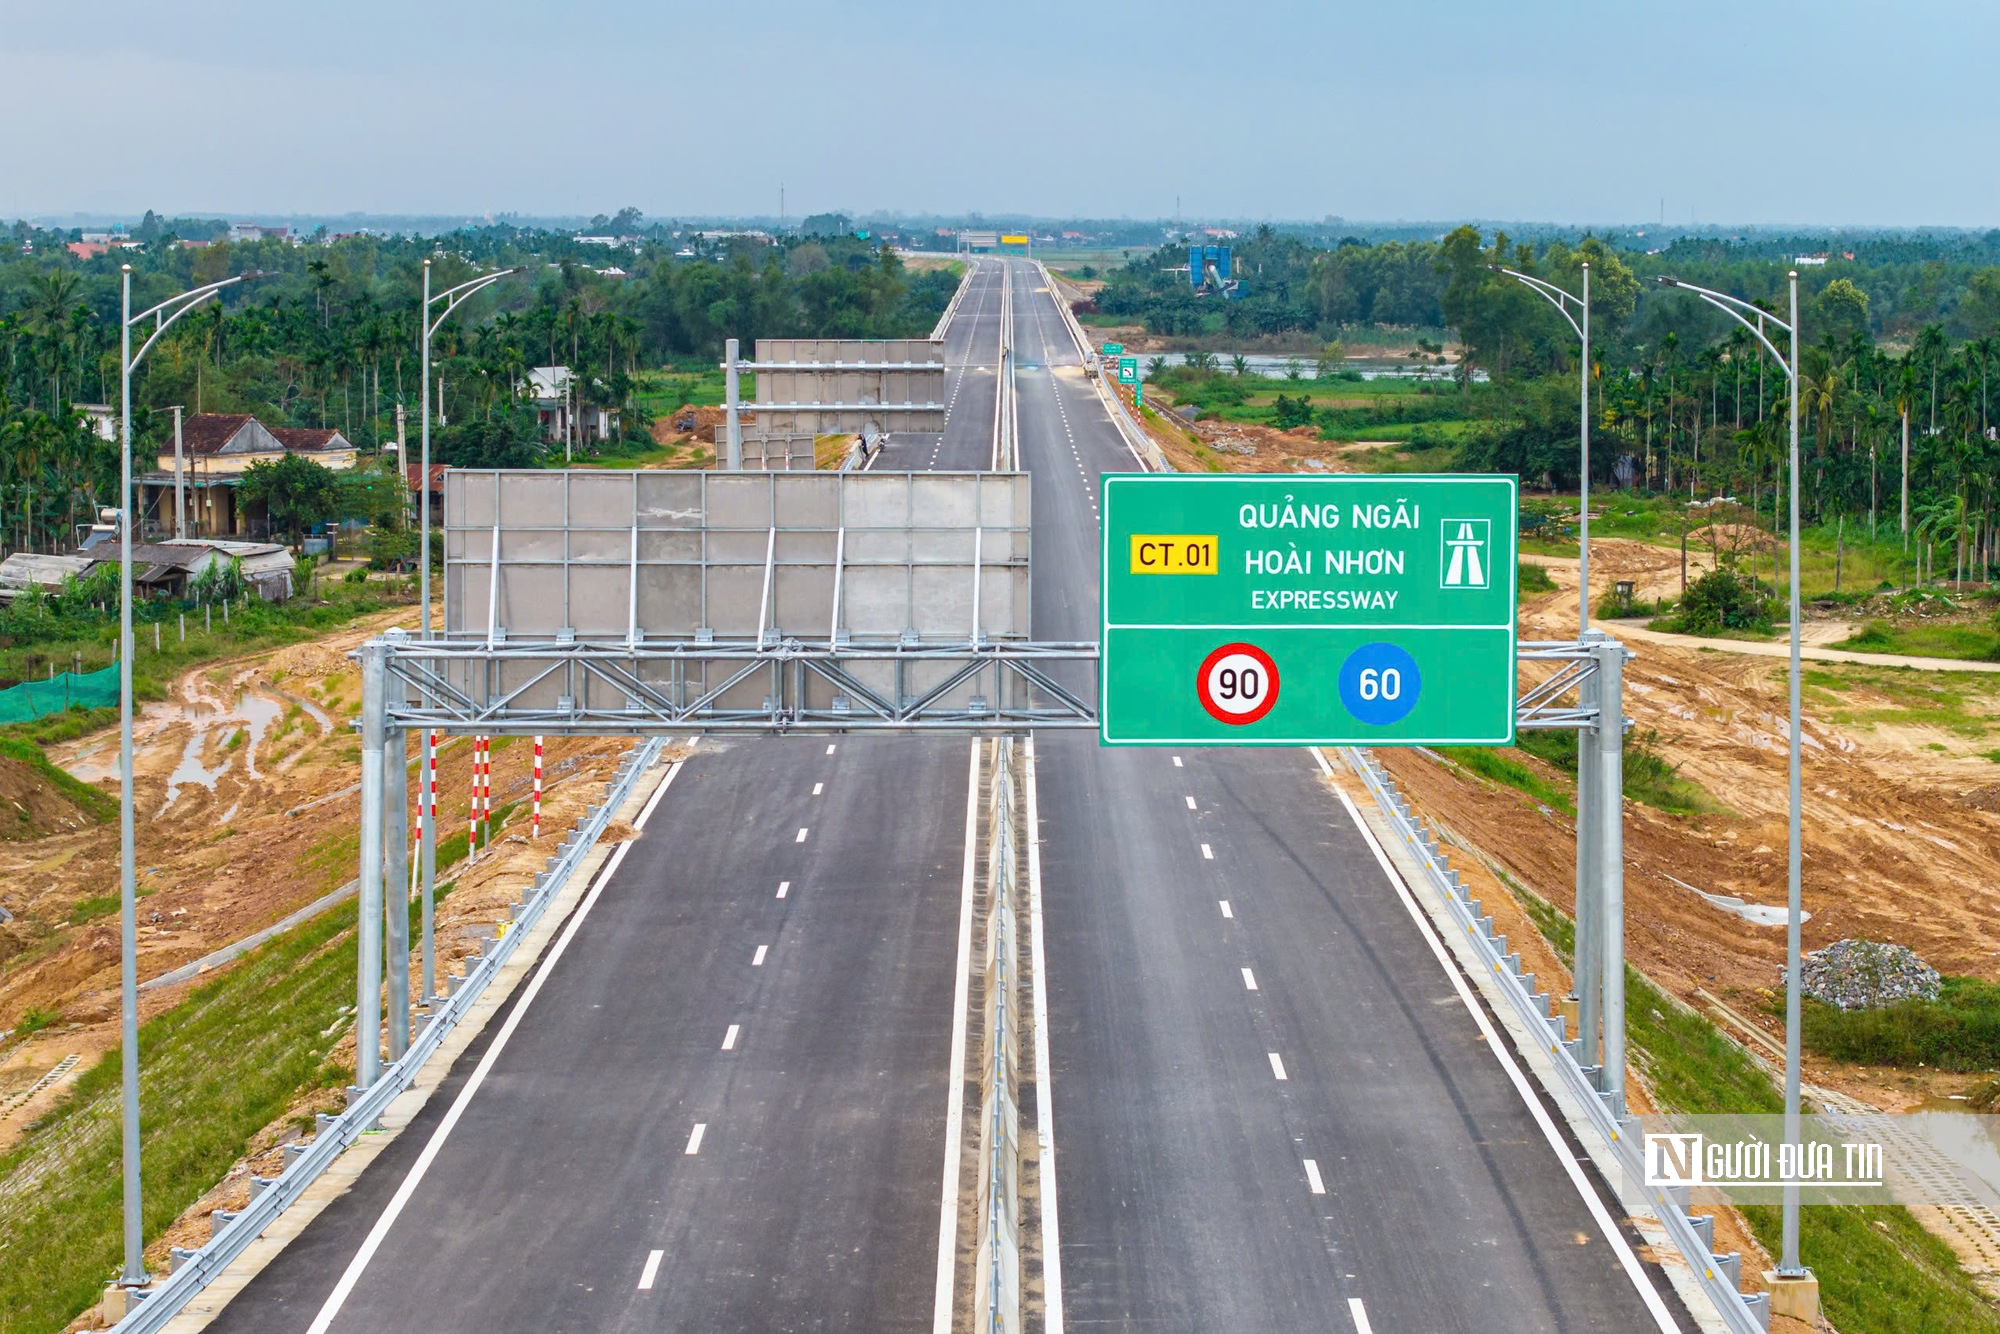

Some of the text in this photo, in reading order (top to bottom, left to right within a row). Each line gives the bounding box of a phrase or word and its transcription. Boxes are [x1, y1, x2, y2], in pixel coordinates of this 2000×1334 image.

[1239, 494, 1420, 529] QUẢNG NGÃI
[1139, 542, 1210, 567] CT.01
[1245, 541, 1405, 575] HOÀI NHƠN
[1251, 590, 1399, 610] EXPRESSWAY
[1219, 668, 1259, 700] 90
[1359, 668, 1401, 701] 60
